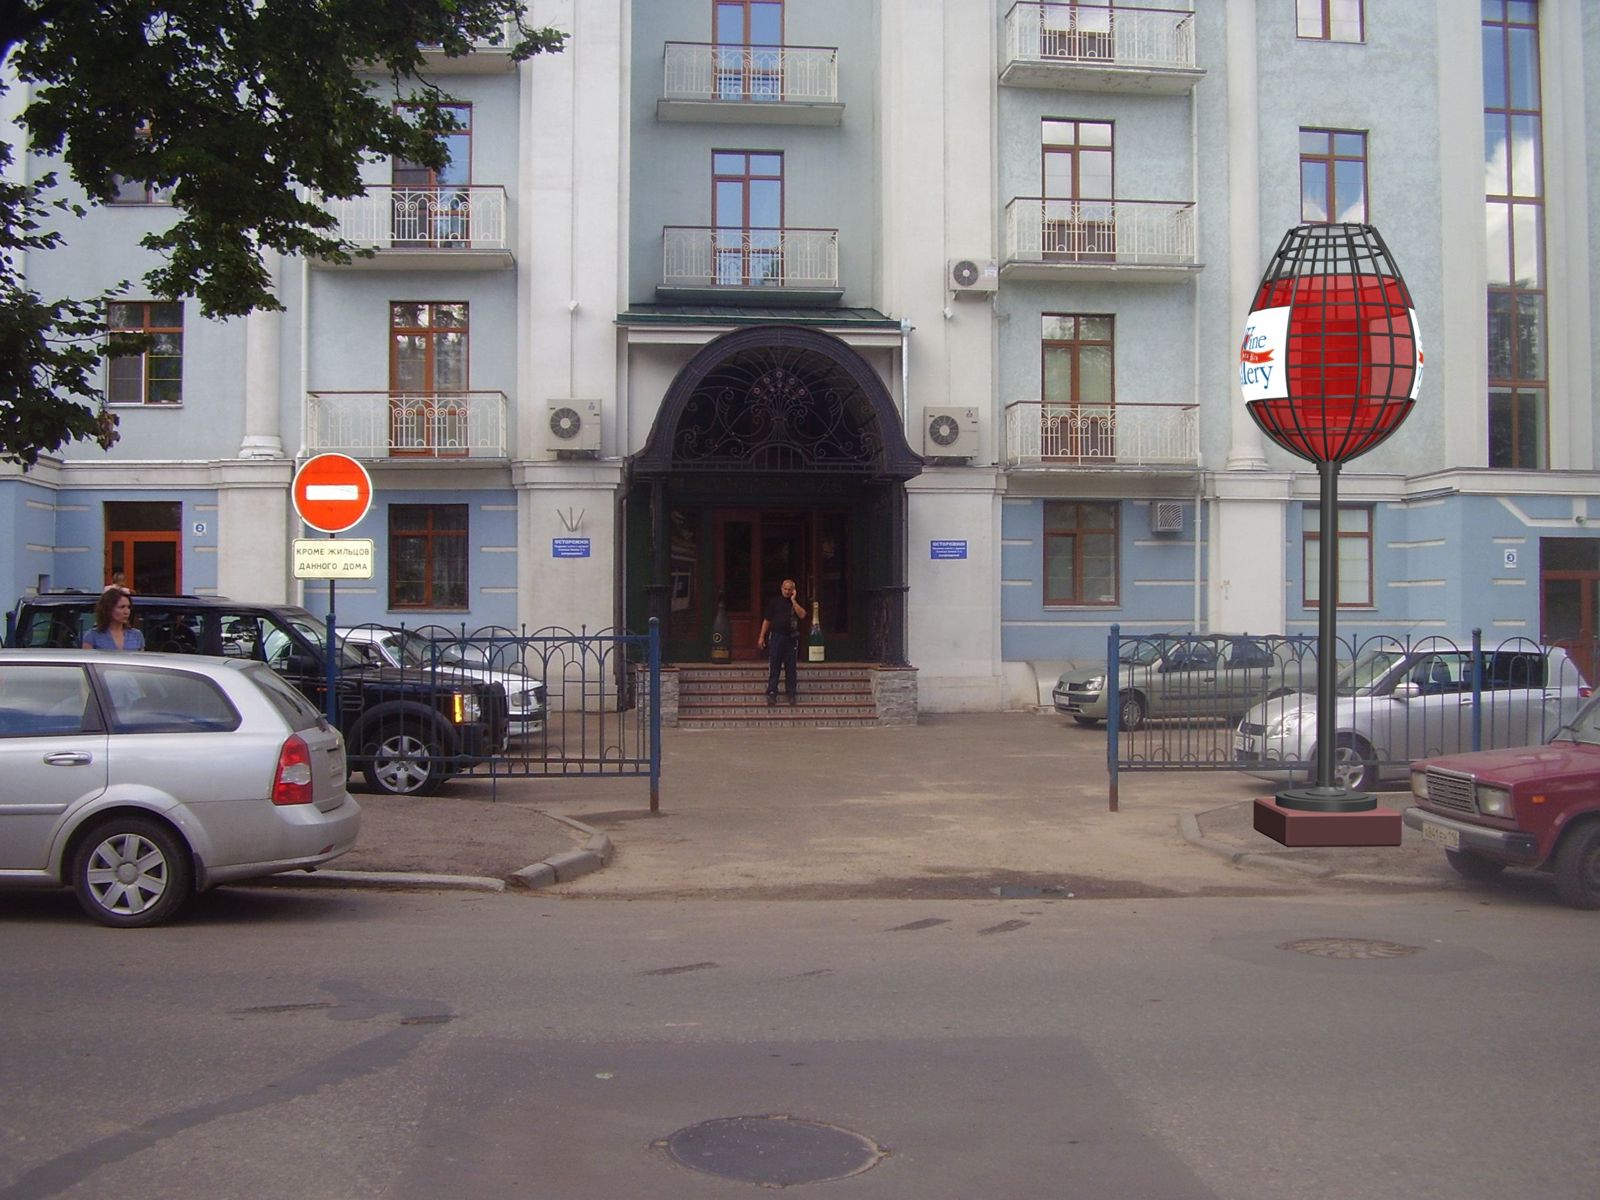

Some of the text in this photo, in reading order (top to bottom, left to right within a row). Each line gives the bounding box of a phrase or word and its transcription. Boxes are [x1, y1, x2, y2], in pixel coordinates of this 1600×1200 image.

[296, 548, 370, 556] КРОМЕ ЖИЛЬЦОВ
[298, 562, 368, 571] ДАННОГО ДОМА
